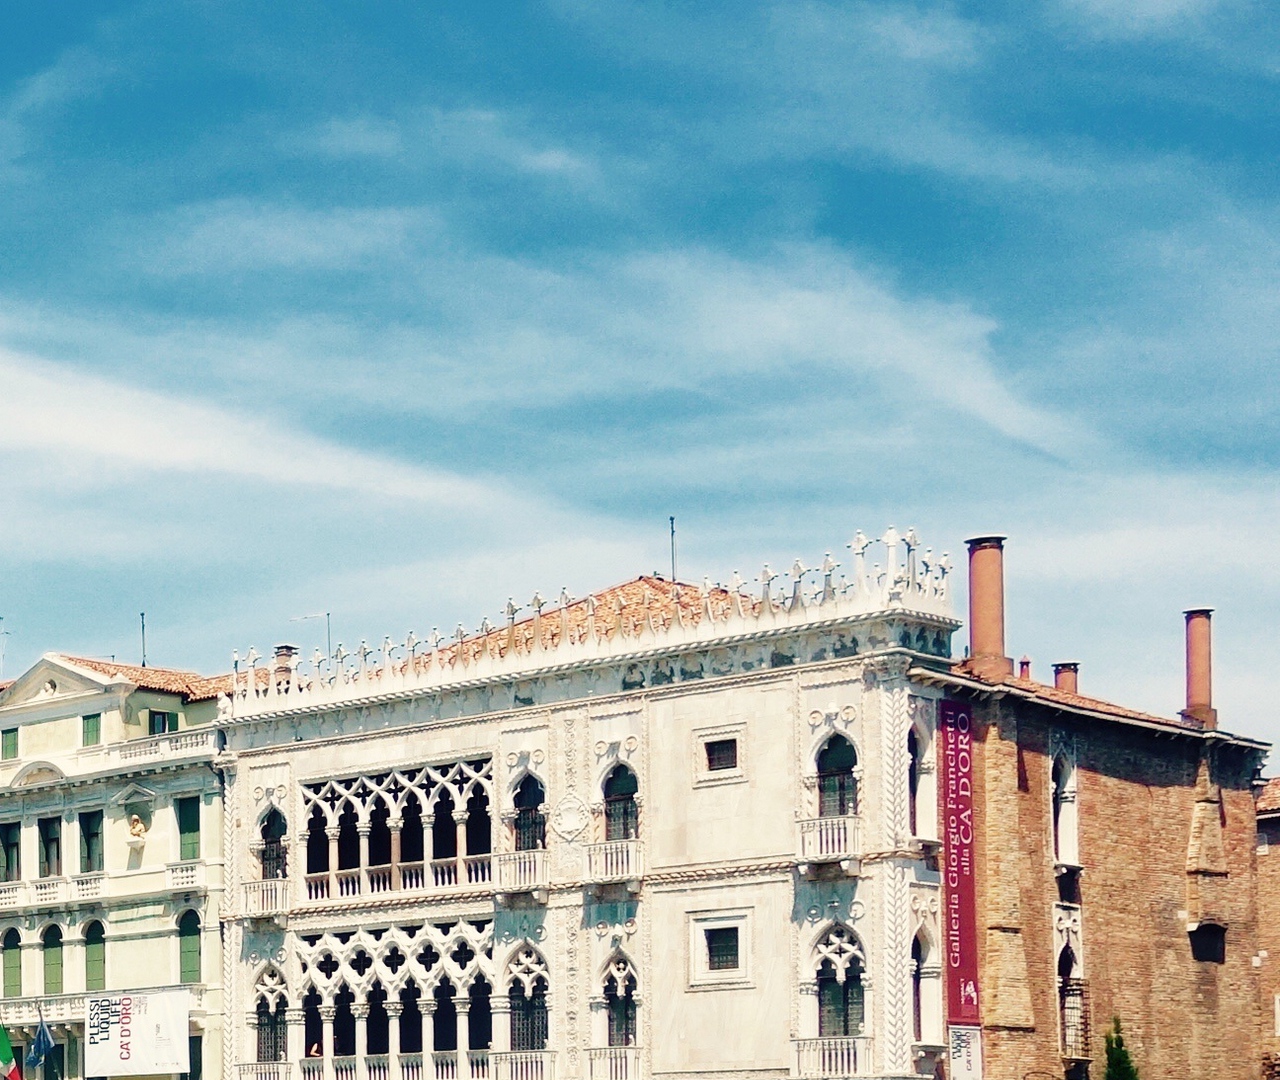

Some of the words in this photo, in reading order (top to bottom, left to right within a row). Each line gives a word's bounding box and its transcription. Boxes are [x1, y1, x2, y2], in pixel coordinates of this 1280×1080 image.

[946, 711, 957, 809] Franchetti
[958, 713, 971, 798] D'ORO
[959, 804, 972, 845] CA'
[948, 815, 961, 888] Giorgio
[961, 849, 970, 875] alla
[950, 894, 960, 968] Galleria
[89, 999, 100, 1045] PLESSI
[99, 998, 111, 1041] LIQUID
[110, 998, 121, 1025] LIFE
[120, 997, 132, 1038] D'ORO
[120, 1040, 131, 1061] CA'
